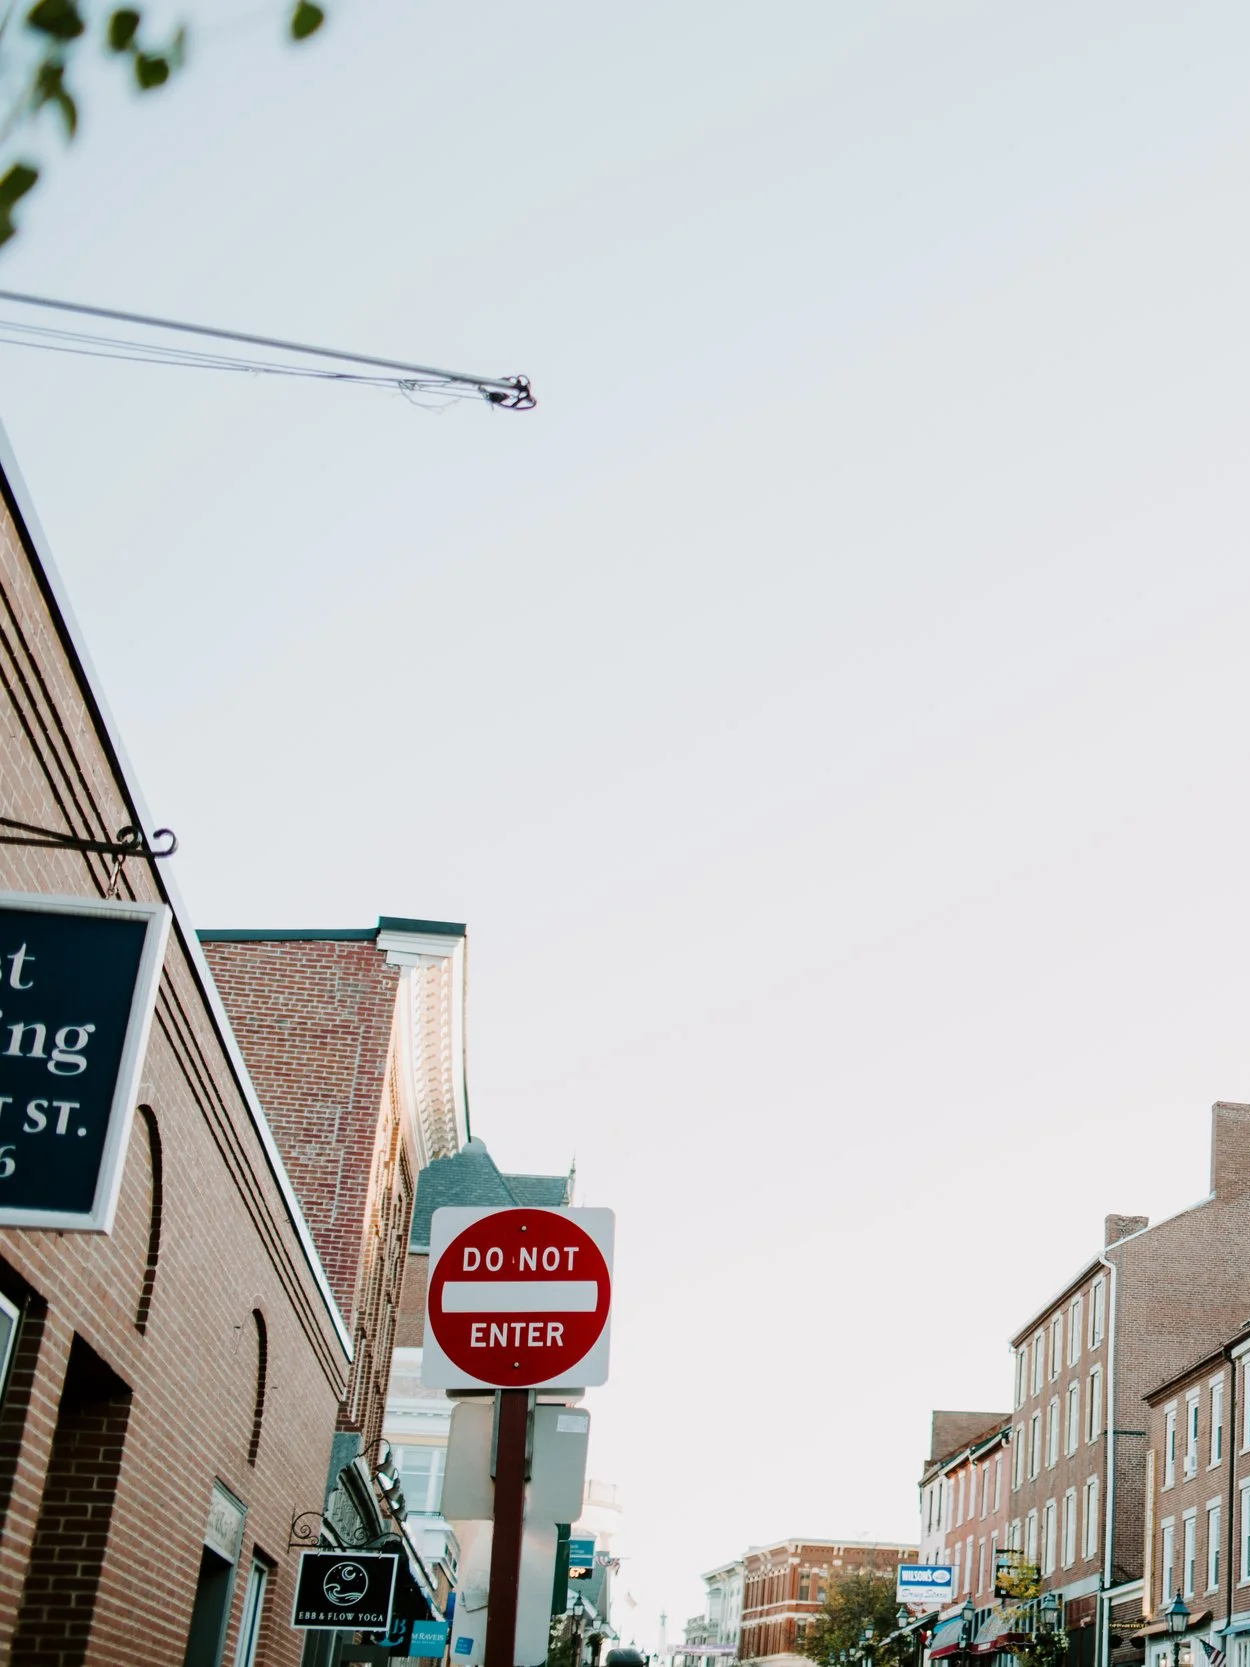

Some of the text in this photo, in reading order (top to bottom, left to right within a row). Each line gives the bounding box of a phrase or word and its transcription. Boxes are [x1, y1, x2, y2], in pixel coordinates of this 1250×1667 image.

[0, 942, 35, 990] t
[0, 1009, 96, 1076] ng
[23, 1099, 87, 1137] ST.
[463, 1246, 579, 1272] DO NOT
[470, 1322, 564, 1348] ENTER
[298, 1611, 384, 1623] EBB & FLOW YOGA
